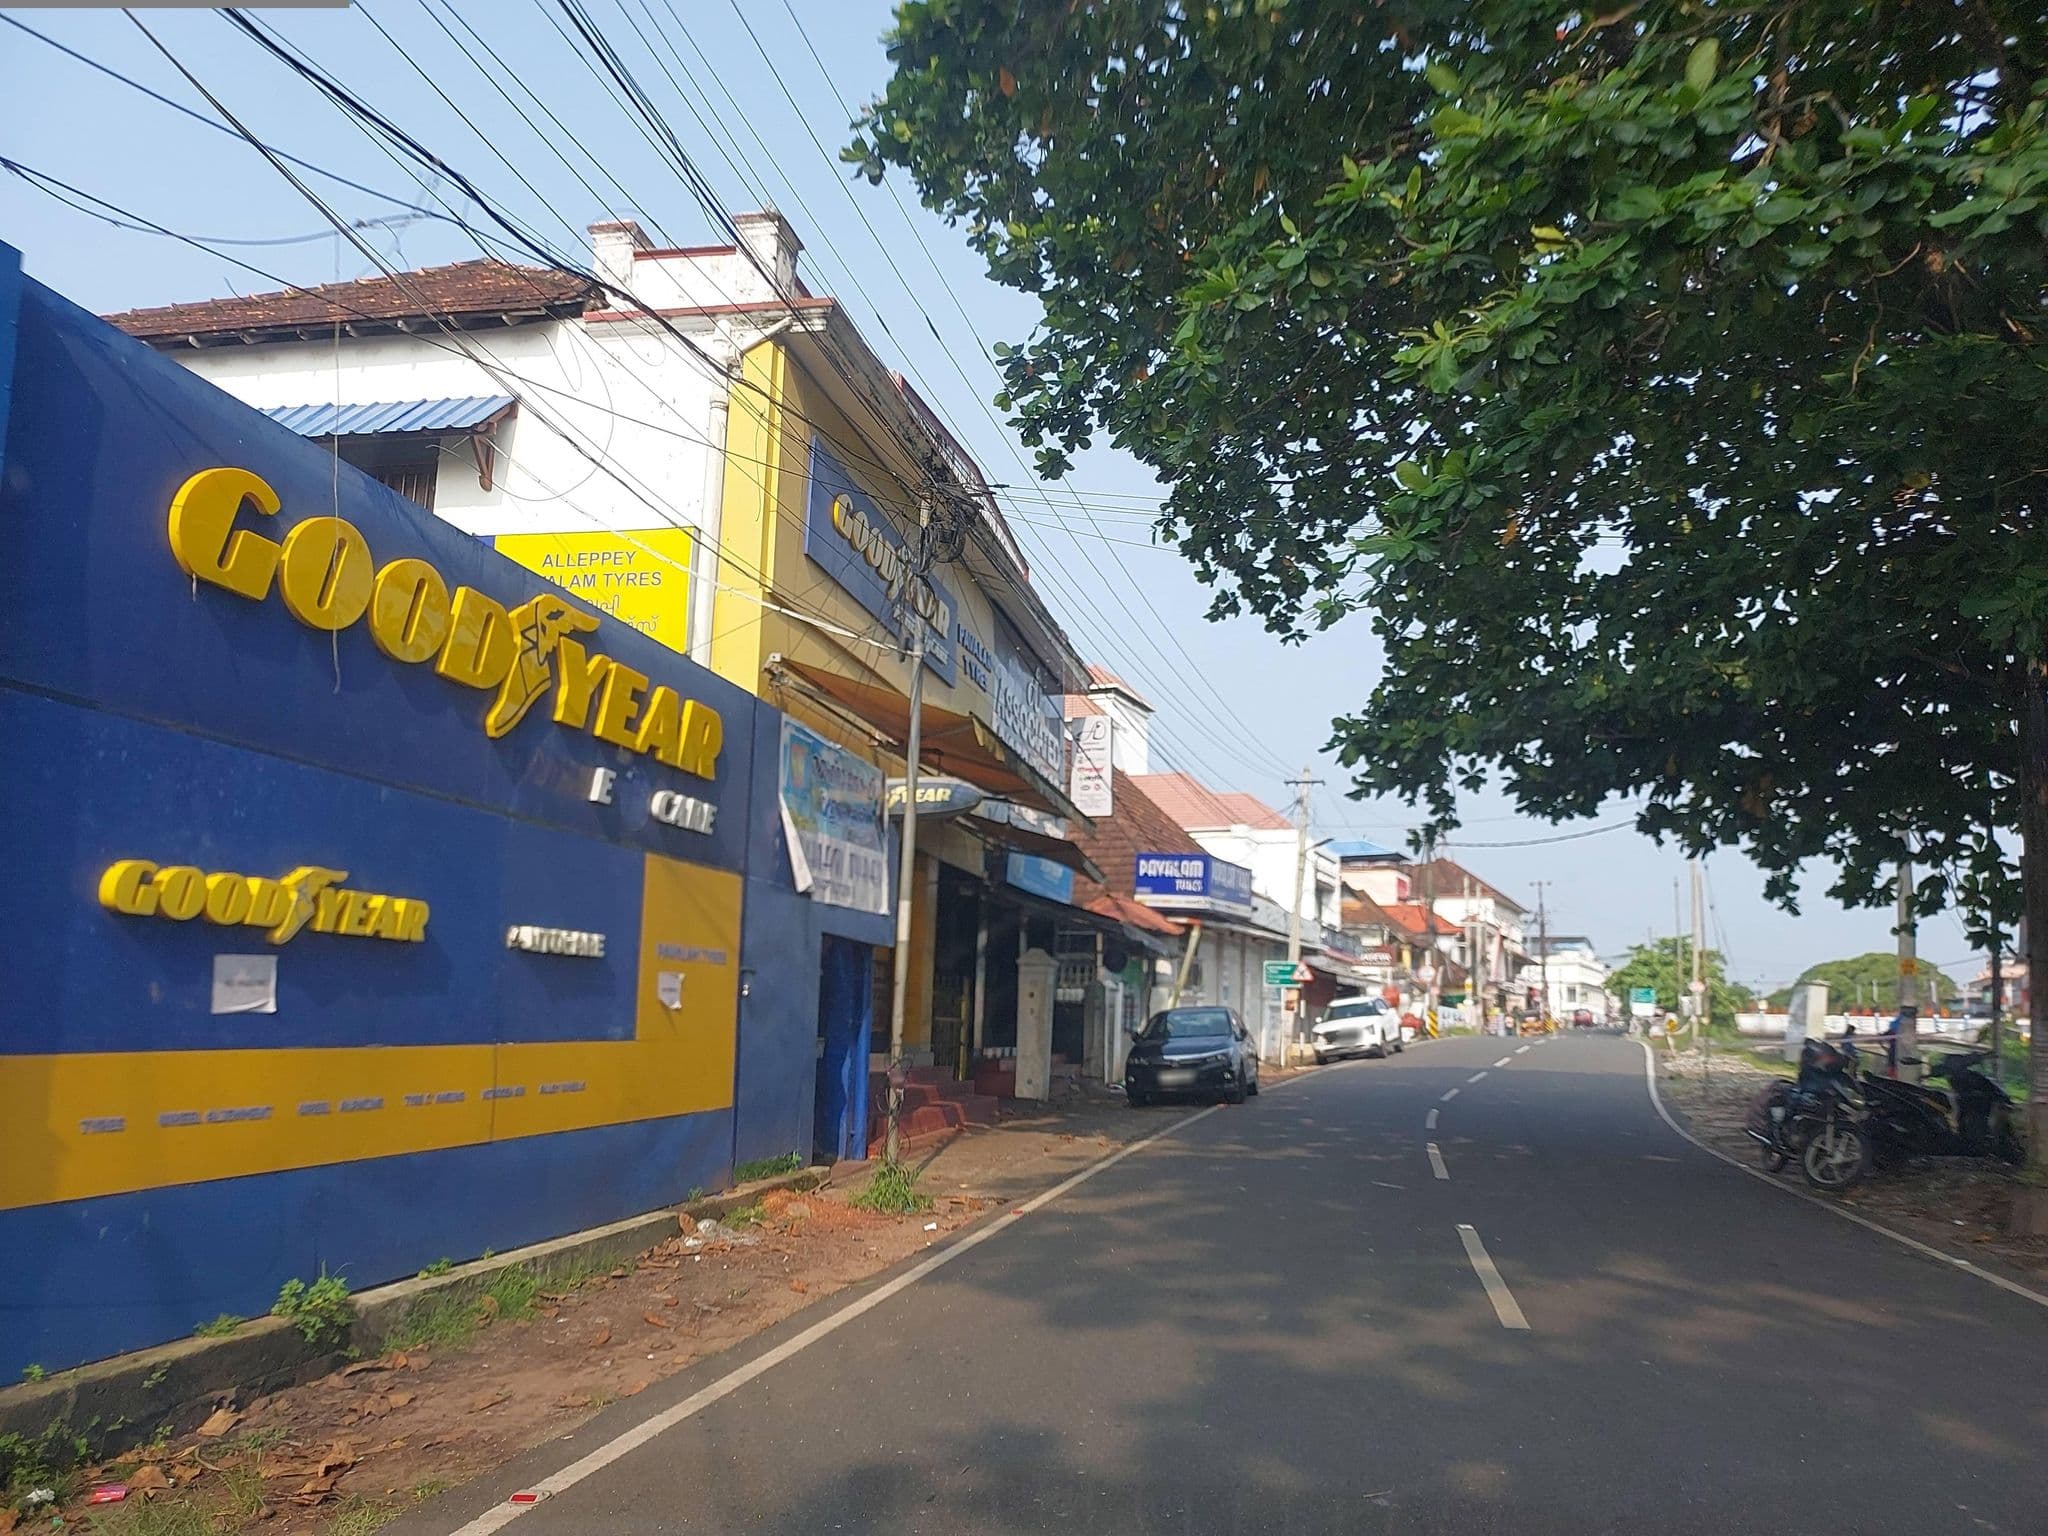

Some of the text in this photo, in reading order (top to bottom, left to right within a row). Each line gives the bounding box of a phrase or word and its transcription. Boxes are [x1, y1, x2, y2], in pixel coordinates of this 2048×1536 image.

[542, 551, 636, 568] ALLEPPEY
[543, 572, 662, 588] ALAM TYRES
[98, 859, 430, 945] GOODYEAR
